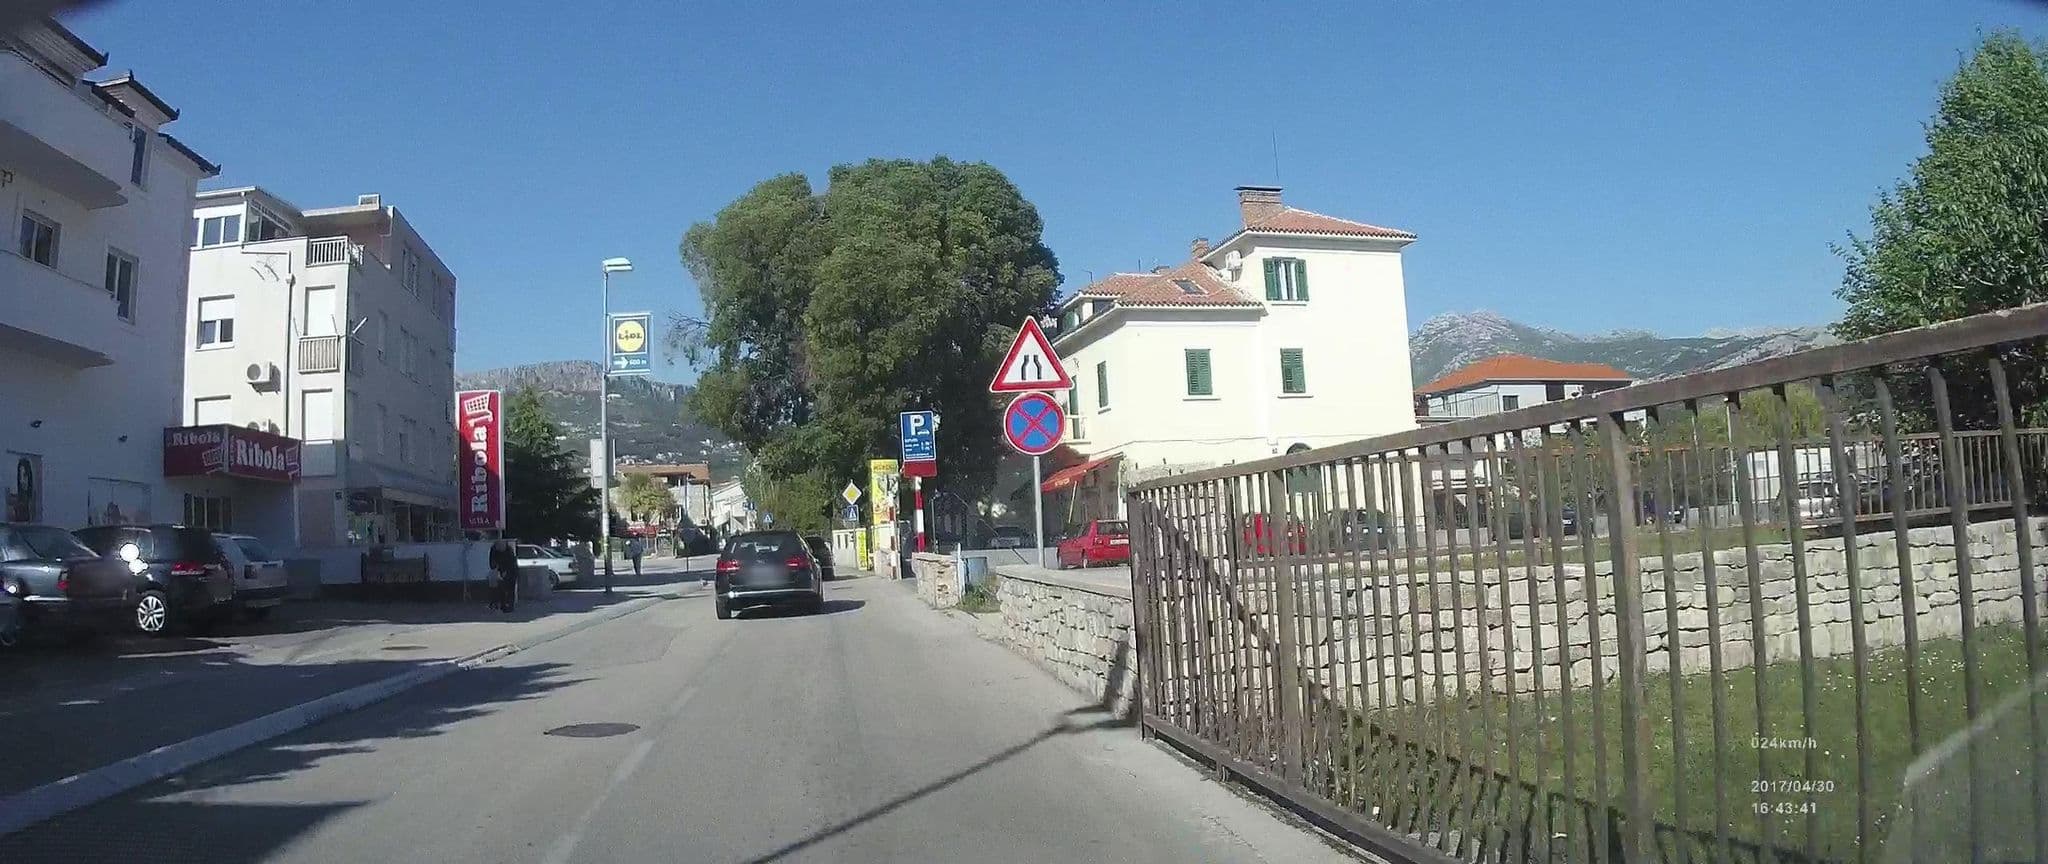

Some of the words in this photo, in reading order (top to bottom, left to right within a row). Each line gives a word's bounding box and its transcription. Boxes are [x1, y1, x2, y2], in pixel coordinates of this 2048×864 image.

[910, 414, 925, 436] P
[172, 431, 221, 447] Ribola
[235, 438, 286, 471] Ribola
[472, 425, 488, 513] Ribola
